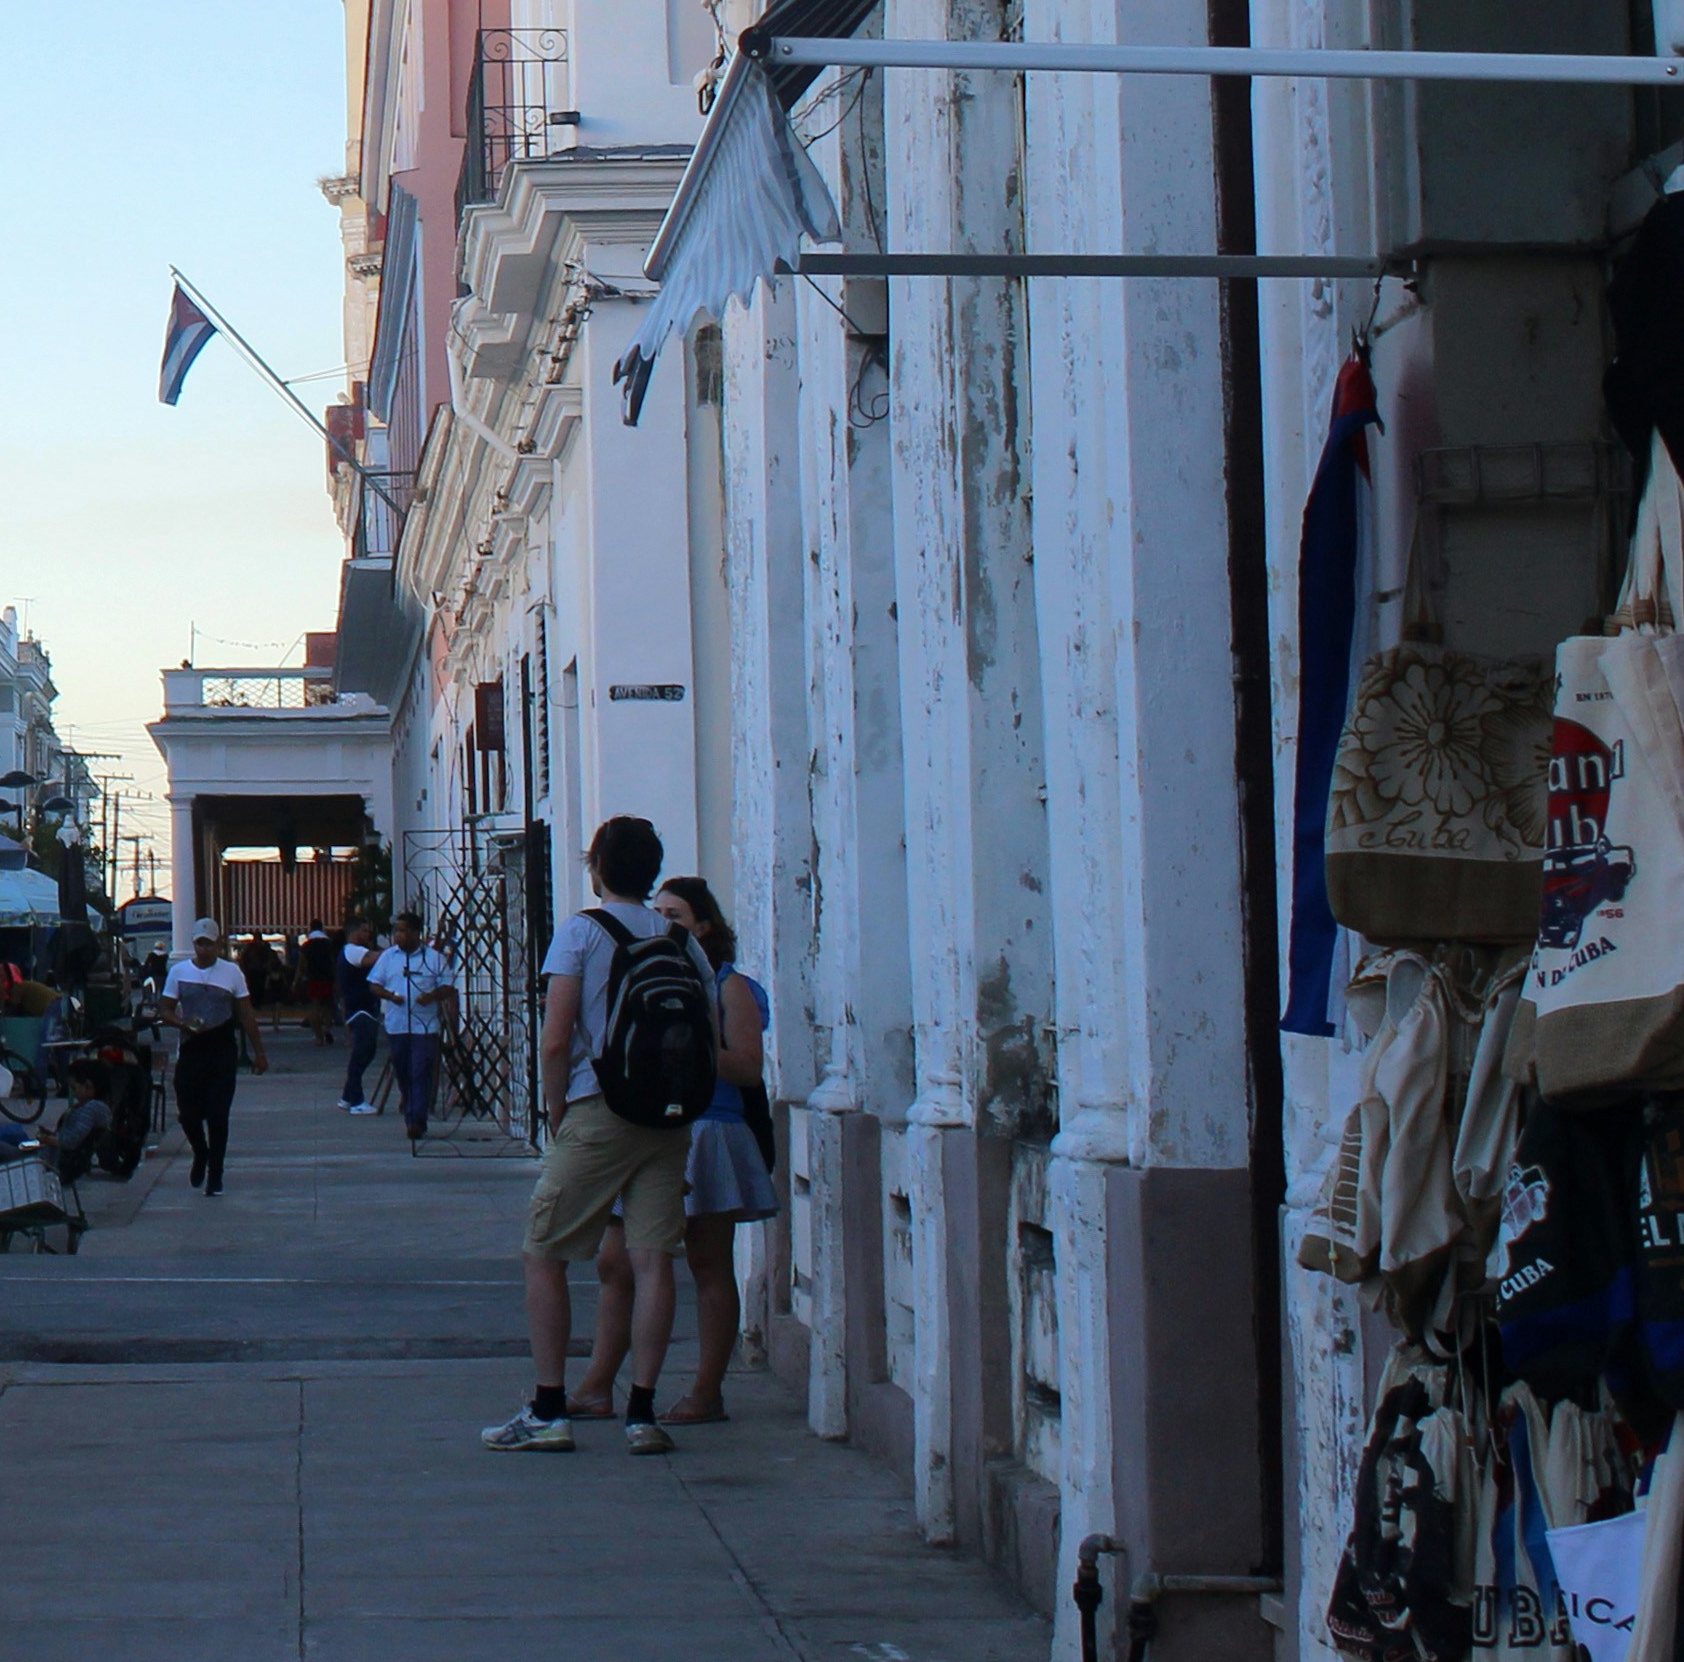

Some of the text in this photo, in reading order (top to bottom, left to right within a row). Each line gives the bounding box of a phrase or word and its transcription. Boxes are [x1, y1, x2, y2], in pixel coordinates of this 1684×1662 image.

[613, 687, 683, 700] AVENIDA 52
[1499, 1257, 1555, 1301] CUBA
